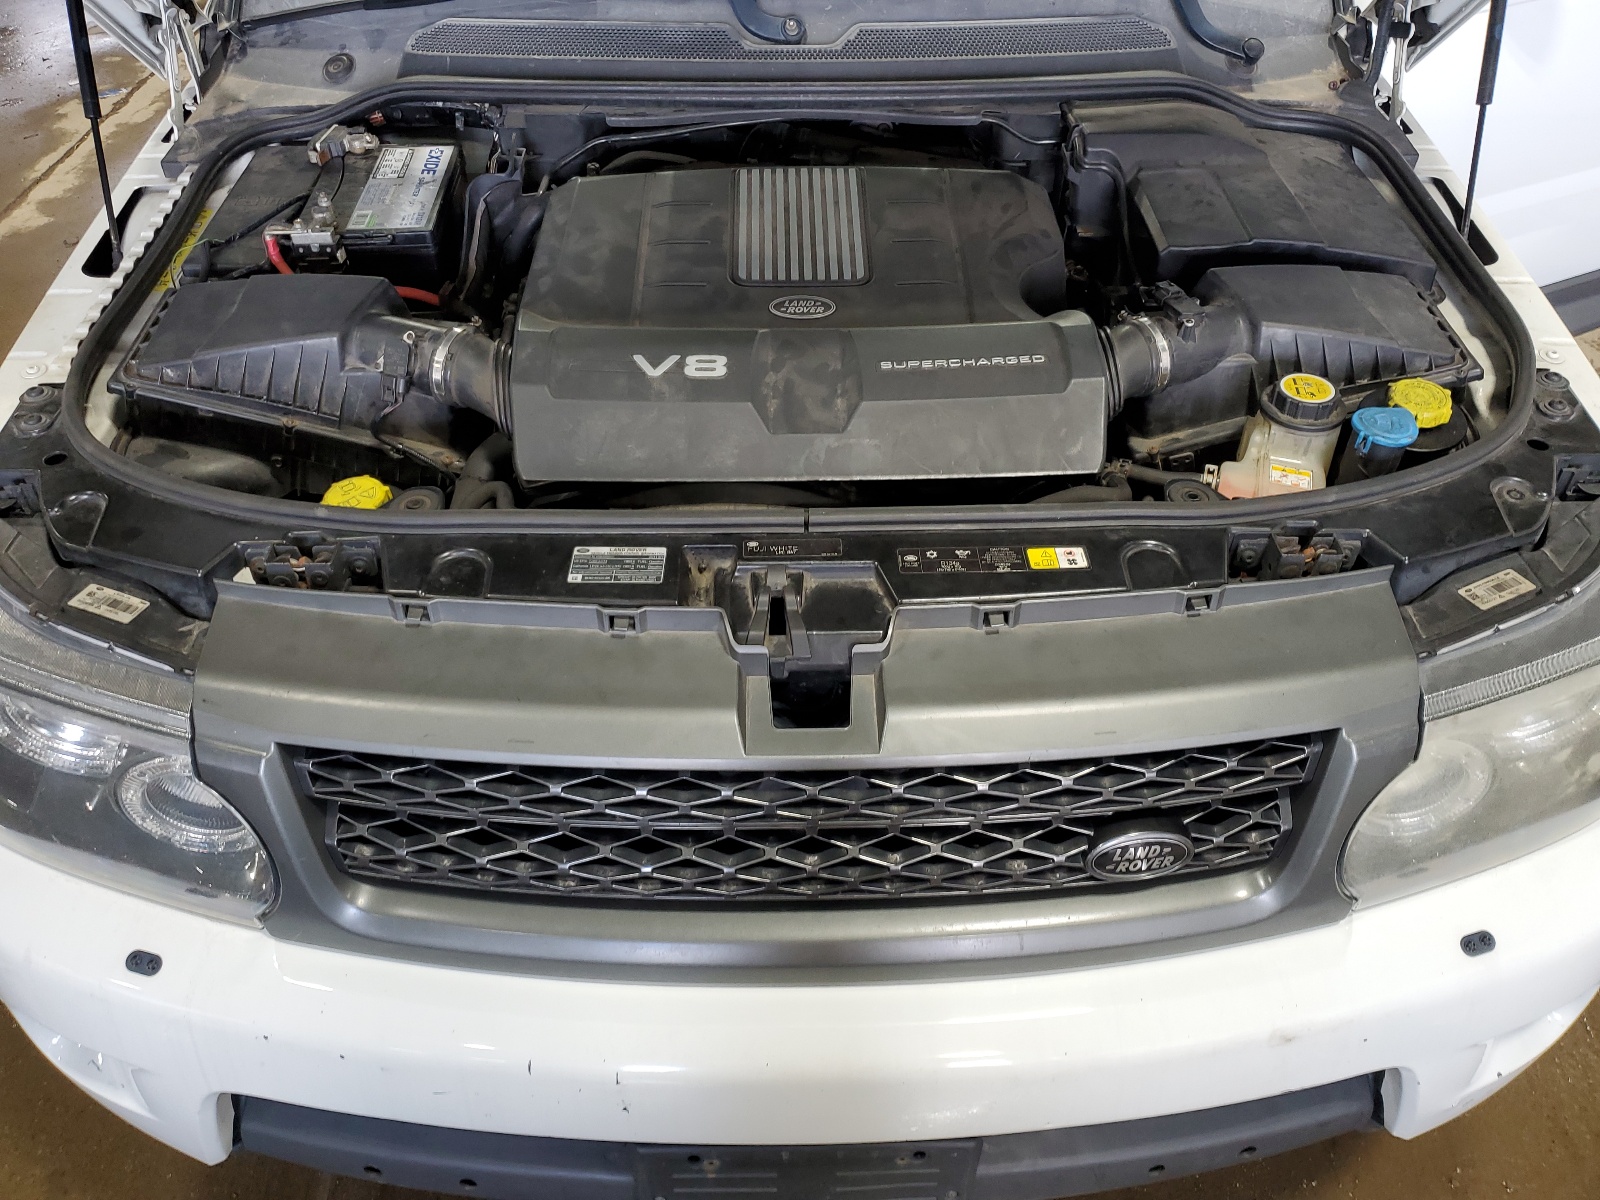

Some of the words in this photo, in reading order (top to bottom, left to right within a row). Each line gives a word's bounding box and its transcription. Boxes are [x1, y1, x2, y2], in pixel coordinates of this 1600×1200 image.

[421, 148, 444, 176] EXIDE
[633, 354, 728, 377] V8
[880, 354, 1045, 369] SUPERCHARGED
[1113, 845, 1161, 862] LAND
[1115, 855, 1175, 873] ROVER
